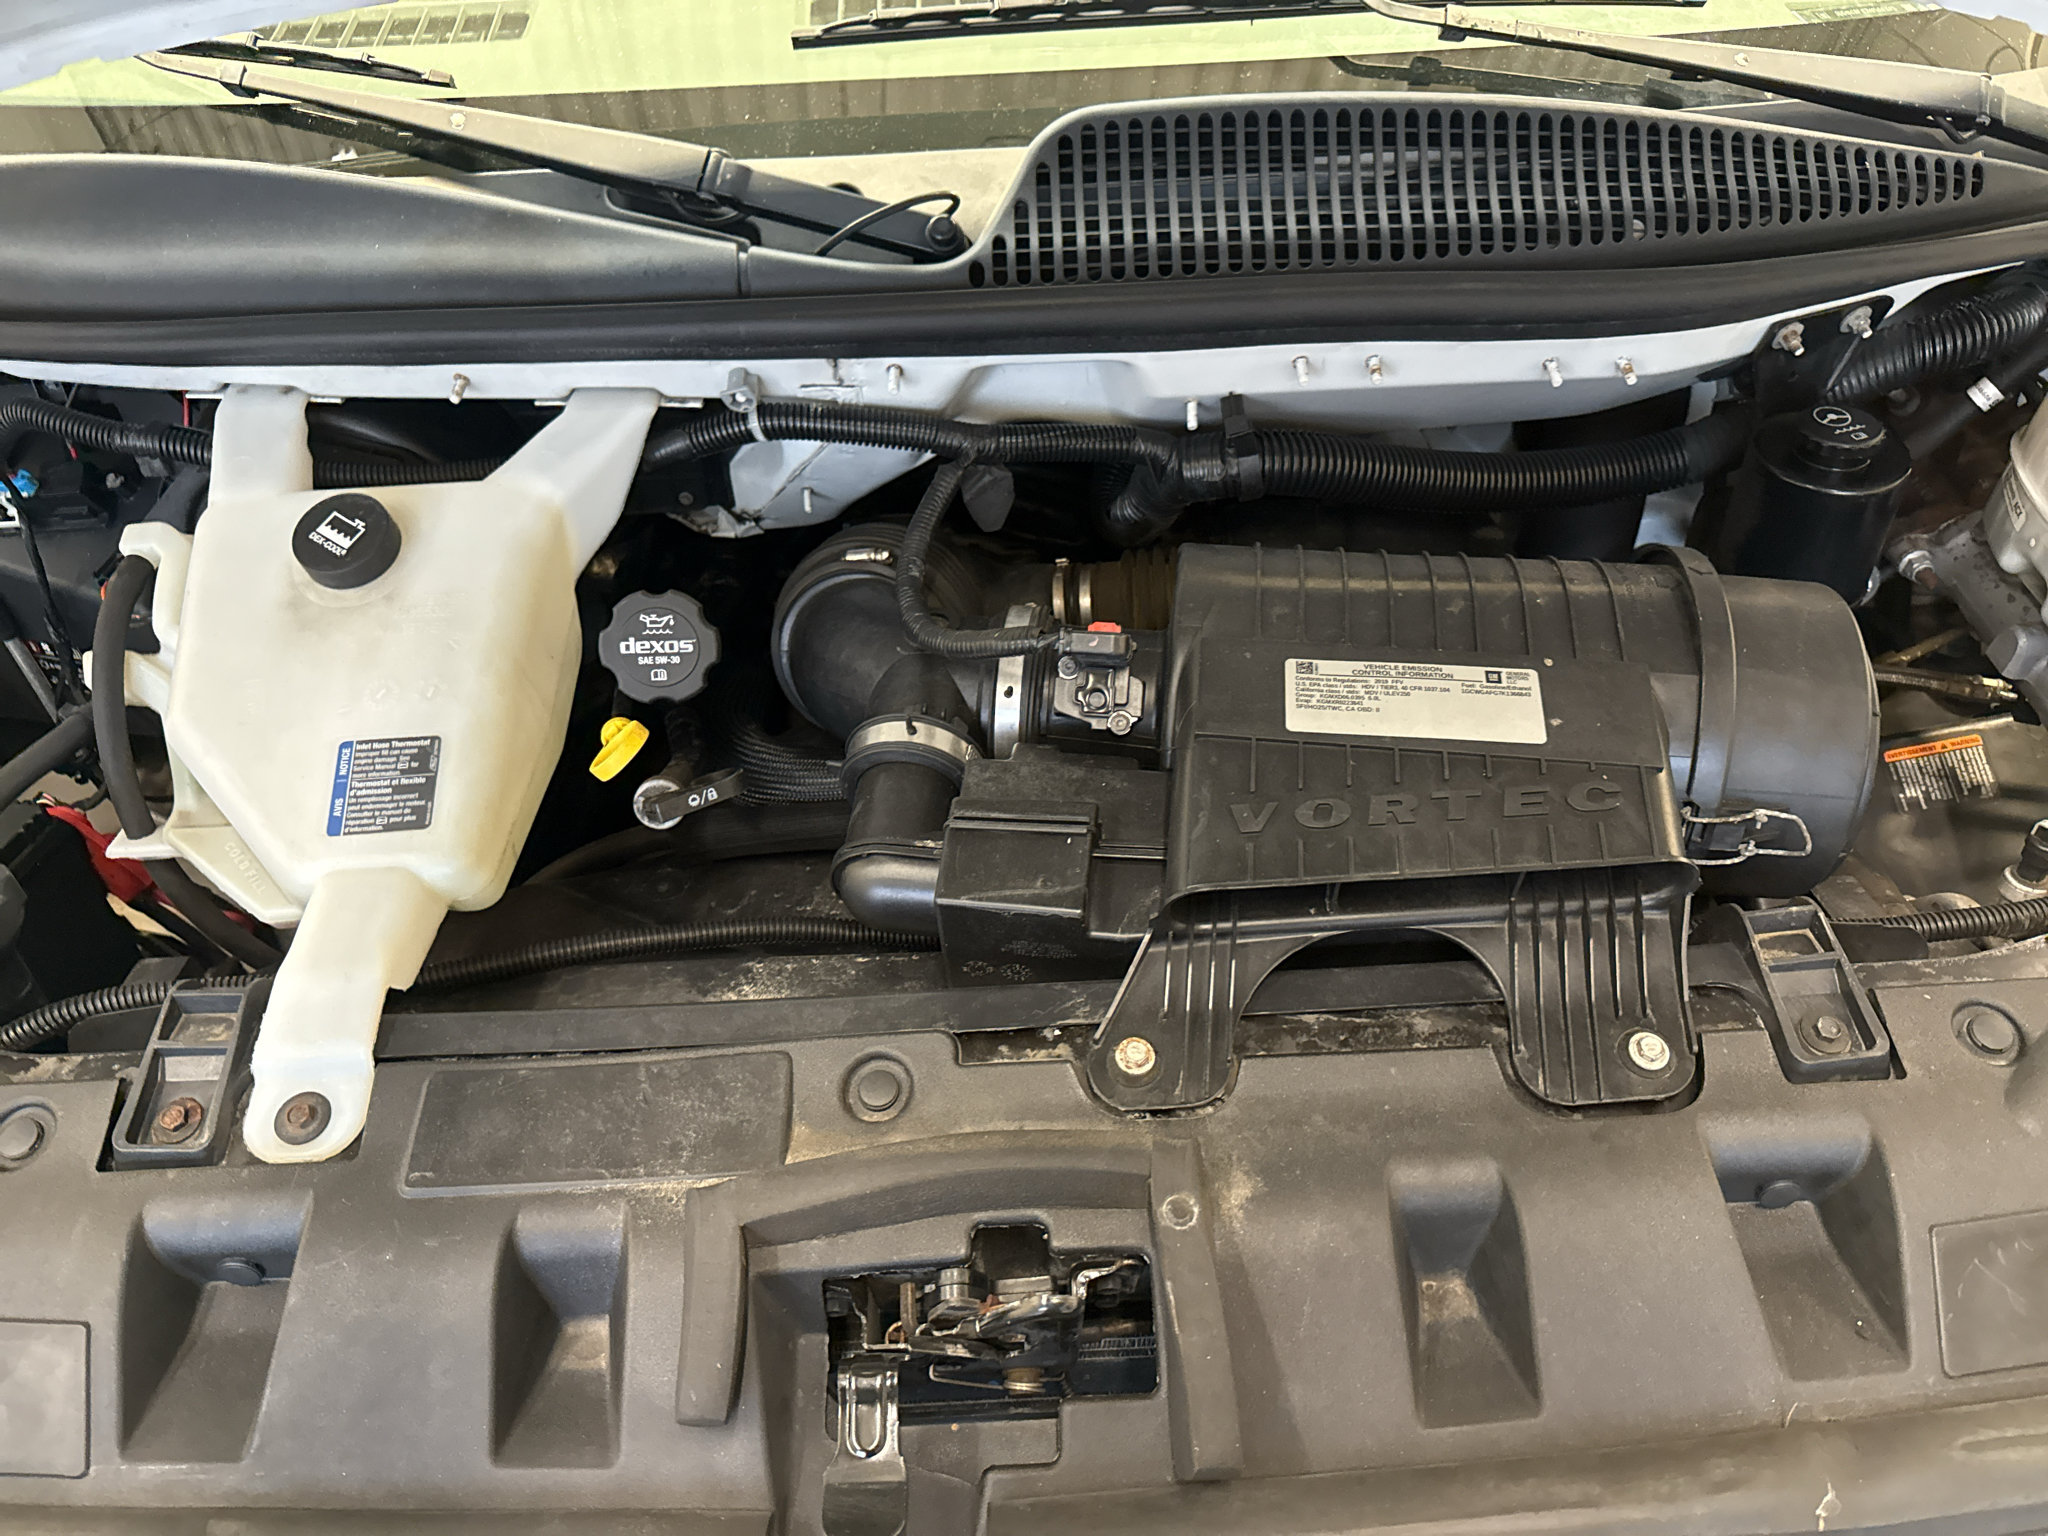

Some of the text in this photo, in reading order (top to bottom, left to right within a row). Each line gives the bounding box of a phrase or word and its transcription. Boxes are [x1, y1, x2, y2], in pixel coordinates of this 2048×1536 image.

[619, 637, 697, 654] dexos
[638, 656, 681, 665] SAE 5W-30
[372, 742, 390, 750] Hose
[391, 738, 431, 748] Thermostat
[338, 747, 351, 776] NOTICE
[351, 779, 390, 788] Thermostat
[400, 777, 426, 785] flexible
[350, 787, 392, 796] d'admission
[333, 798, 344, 817] AVIS
[1229, 780, 1624, 834] VORTEC
[224, 842, 266, 896] COLD FILL
